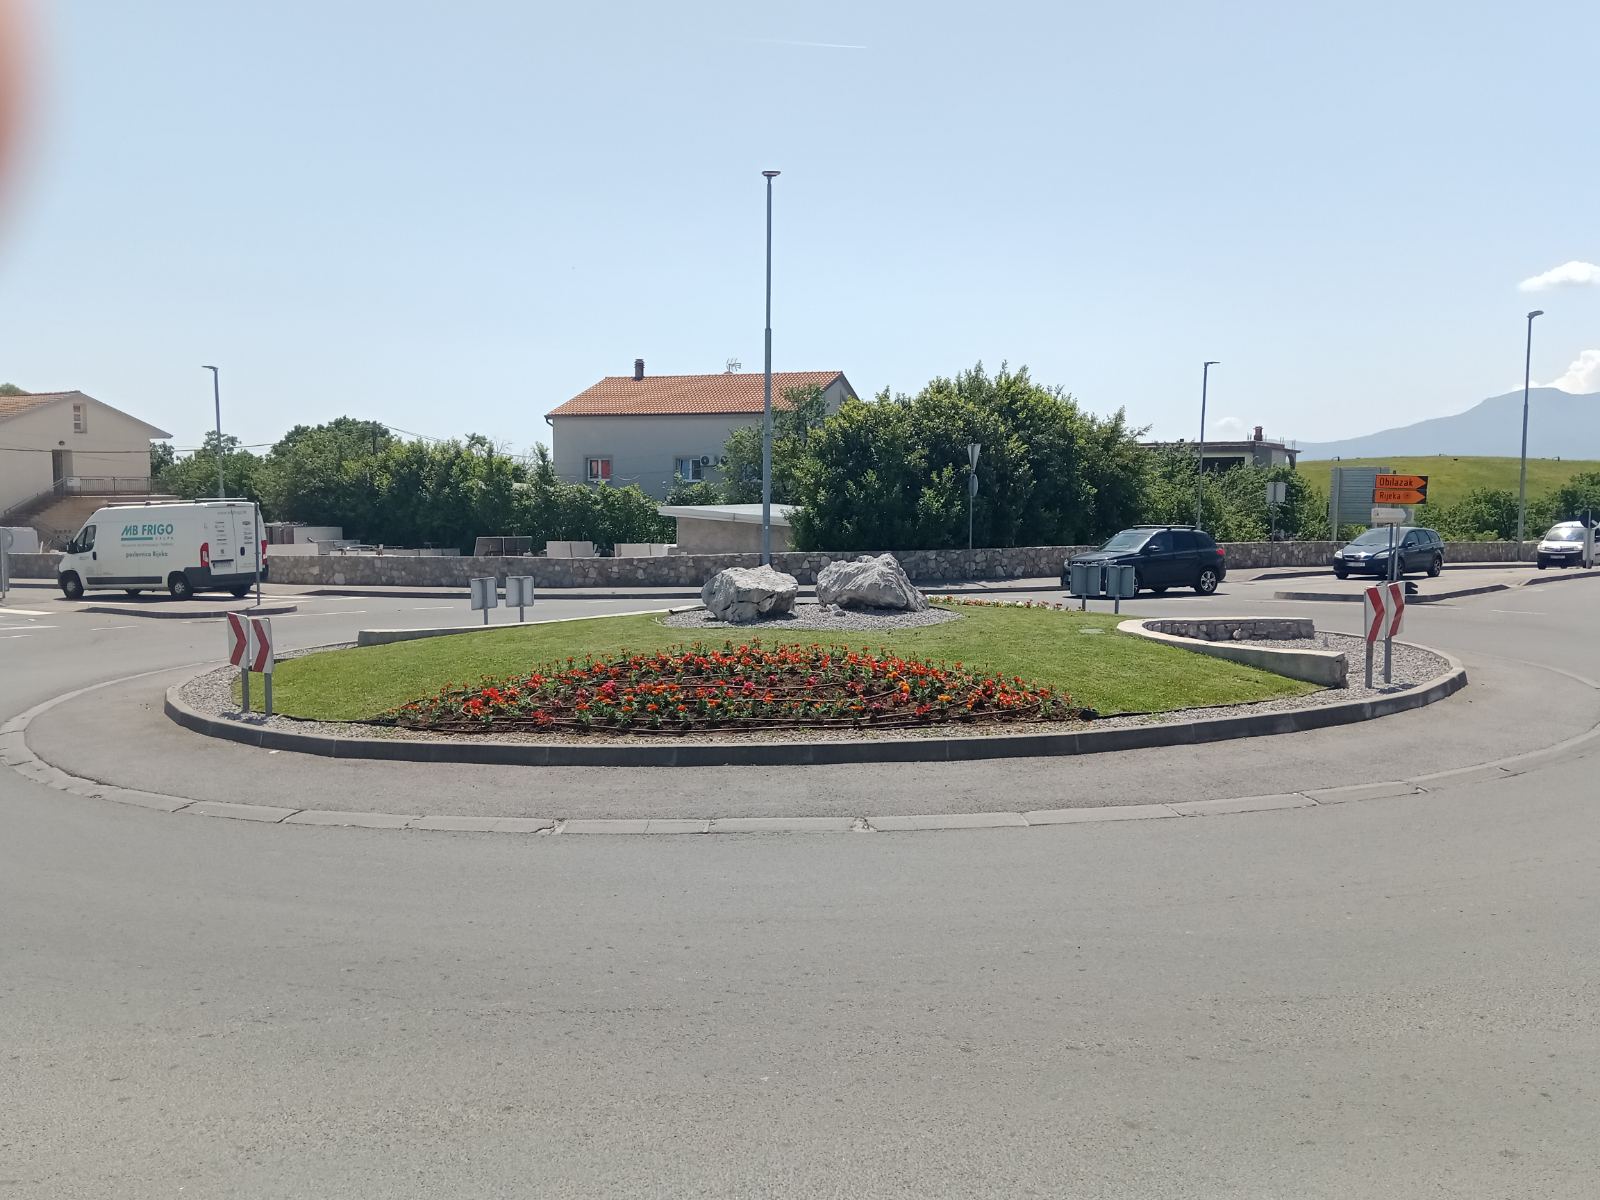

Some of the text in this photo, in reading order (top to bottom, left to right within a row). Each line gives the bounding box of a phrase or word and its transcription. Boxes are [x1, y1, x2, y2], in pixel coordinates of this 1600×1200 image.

[1379, 477, 1414, 487] Obilazak
[1379, 491, 1401, 501] Rijeka
[121, 523, 174, 536] MB FRIGO
